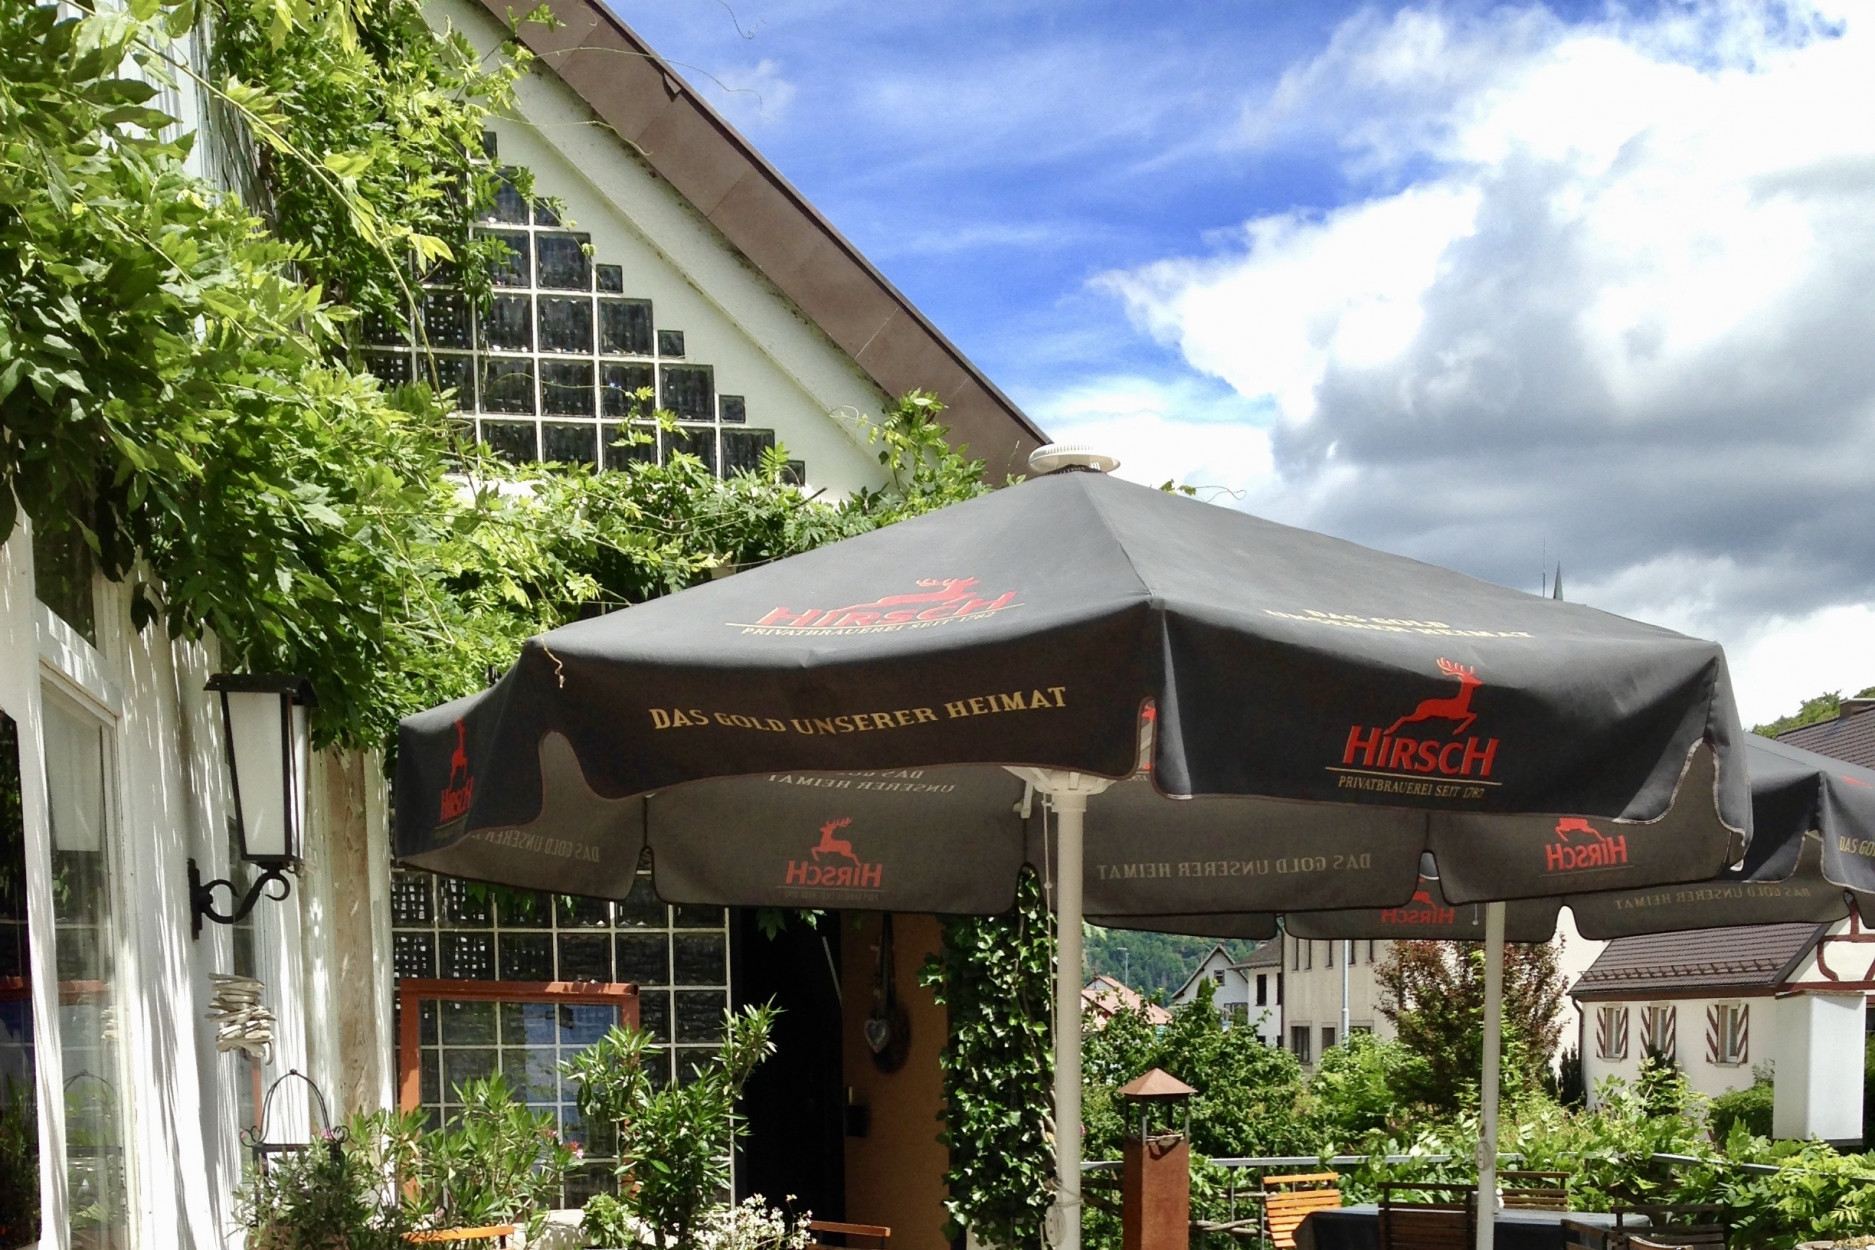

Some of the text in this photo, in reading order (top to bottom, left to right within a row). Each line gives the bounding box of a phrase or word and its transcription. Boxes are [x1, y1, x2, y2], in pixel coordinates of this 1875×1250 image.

[756, 590, 1019, 627] HIRSCH
[649, 686, 1066, 735] DAS GOLD UNSERER HEIMAT
[1342, 725, 1499, 777] HIRSCH
[1338, 776, 1486, 799] PRIVATBRAUEREI SEIT 1782
[1839, 835, 1859, 854] DAS
